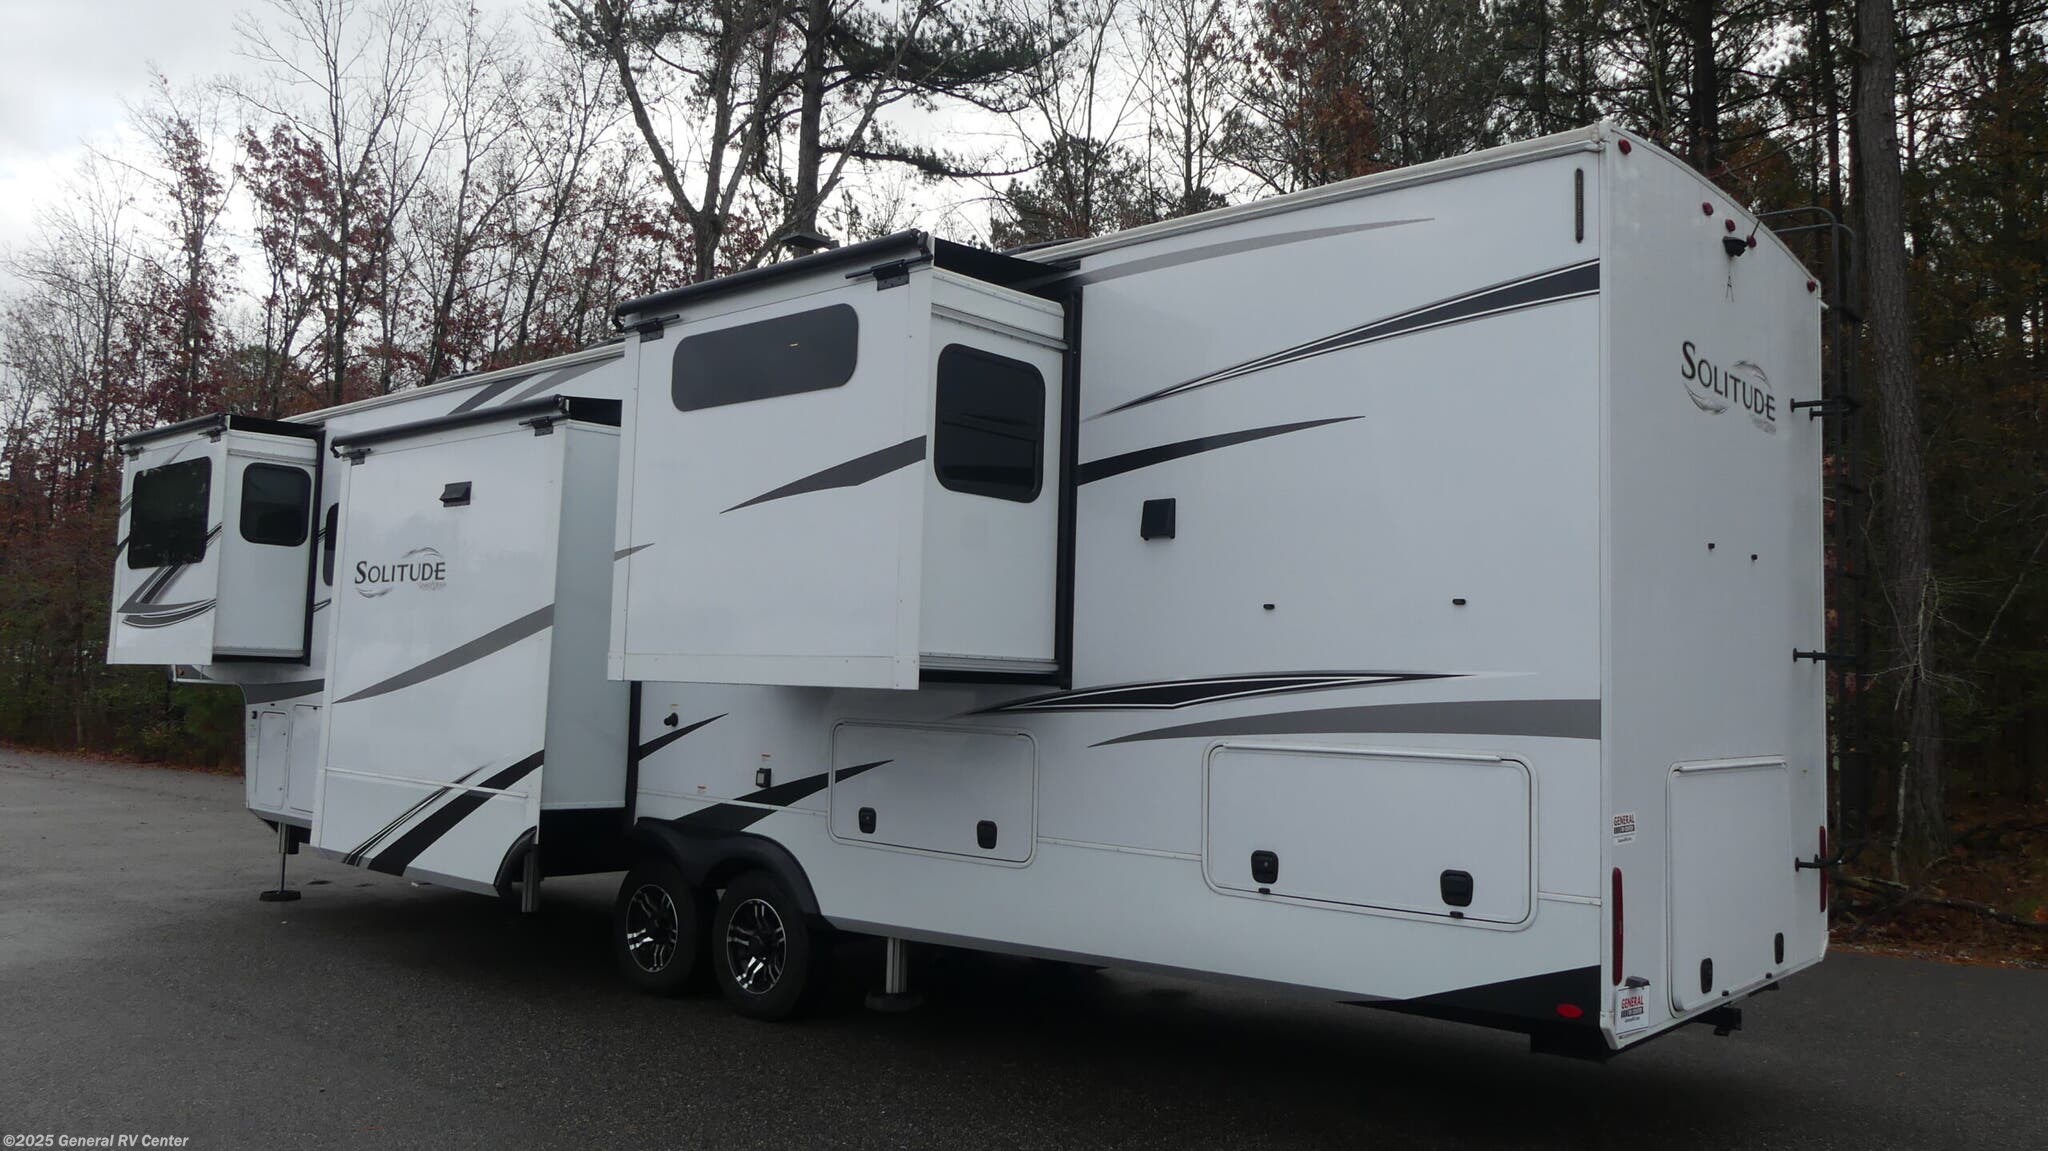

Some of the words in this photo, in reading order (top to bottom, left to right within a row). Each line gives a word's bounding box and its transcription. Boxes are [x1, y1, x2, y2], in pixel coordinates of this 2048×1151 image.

[1682, 341, 1775, 421] SOLITUDE
[355, 561, 445, 584] SOLITUDE
[1614, 814, 1635, 826] GENERAL
[1621, 995, 1644, 1009] GENERAL
